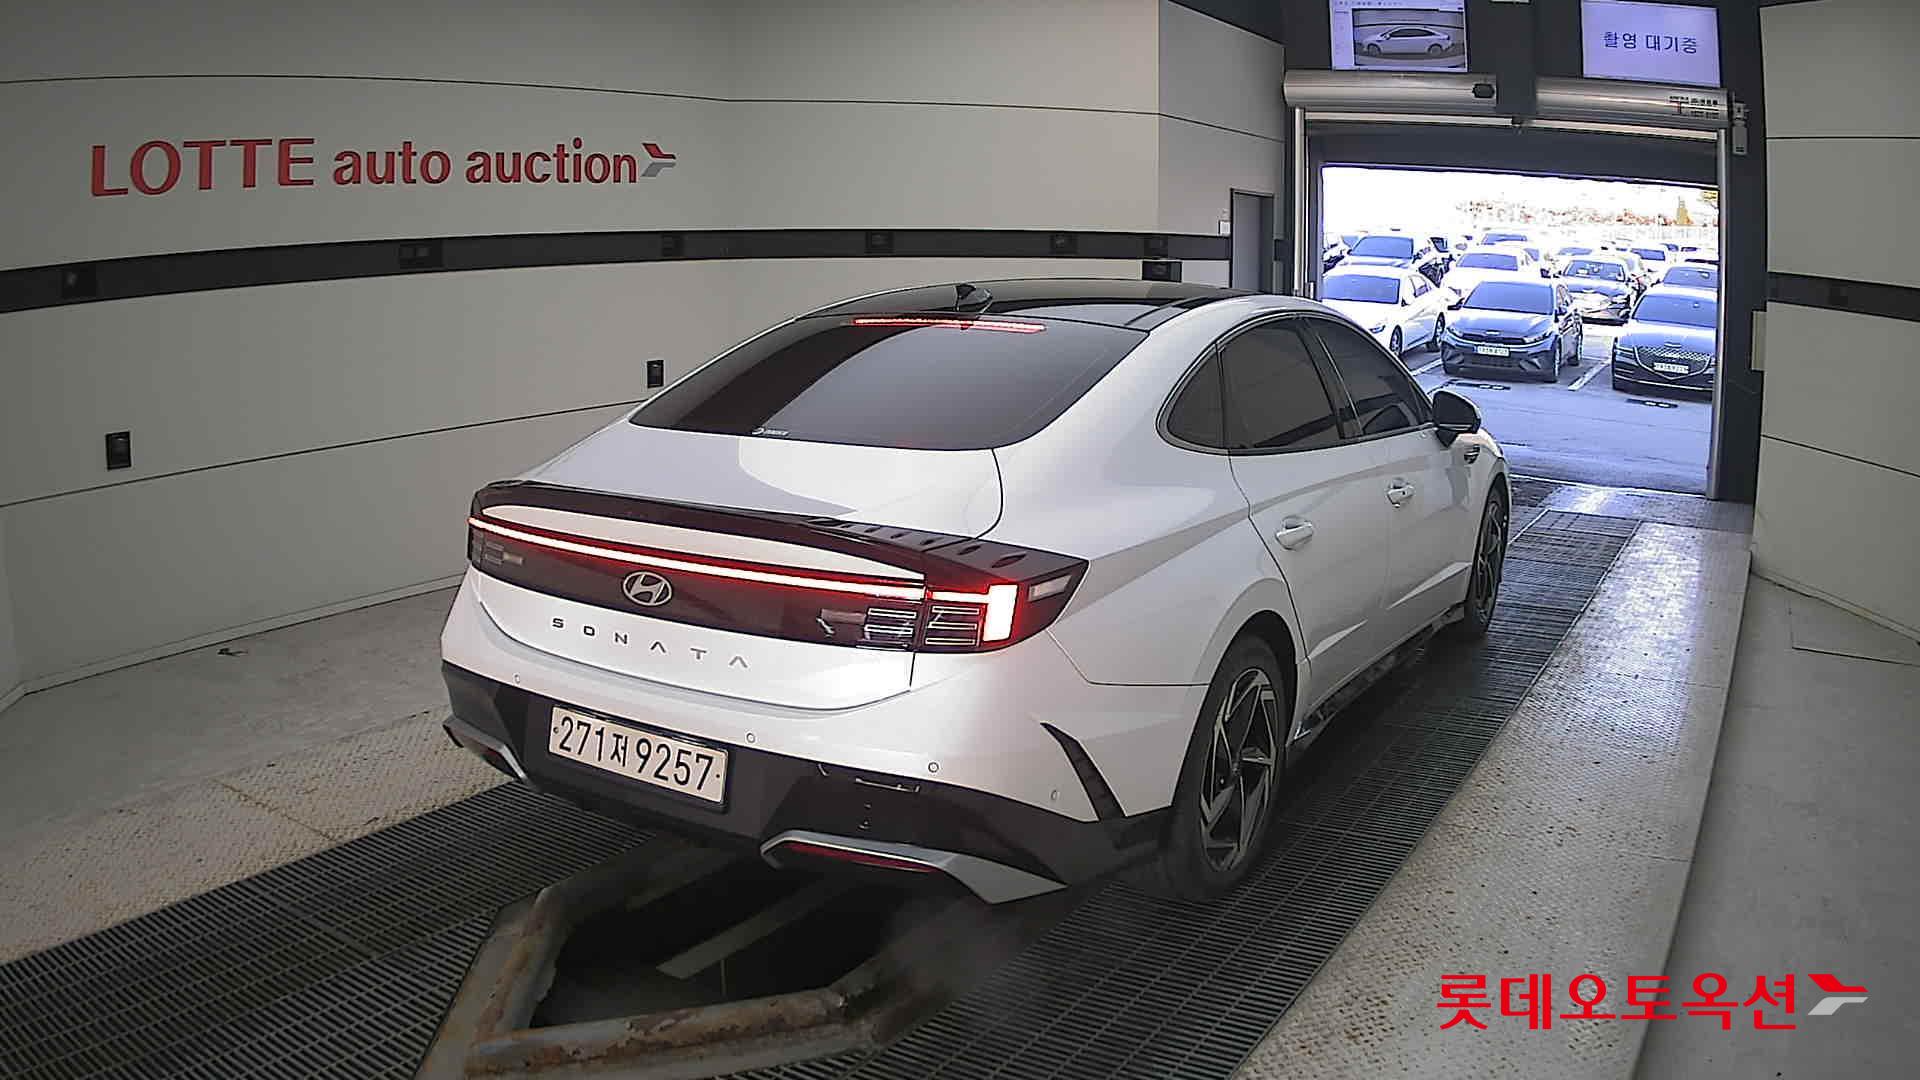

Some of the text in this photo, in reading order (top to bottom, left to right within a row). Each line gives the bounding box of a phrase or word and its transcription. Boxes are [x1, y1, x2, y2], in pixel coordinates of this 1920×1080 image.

[1645, 34, 1697, 54] 대기중
[91, 136, 638, 197] LOTTE auto auction
[552, 617, 748, 668] SONATA
[559, 716, 713, 791] 271저9257
